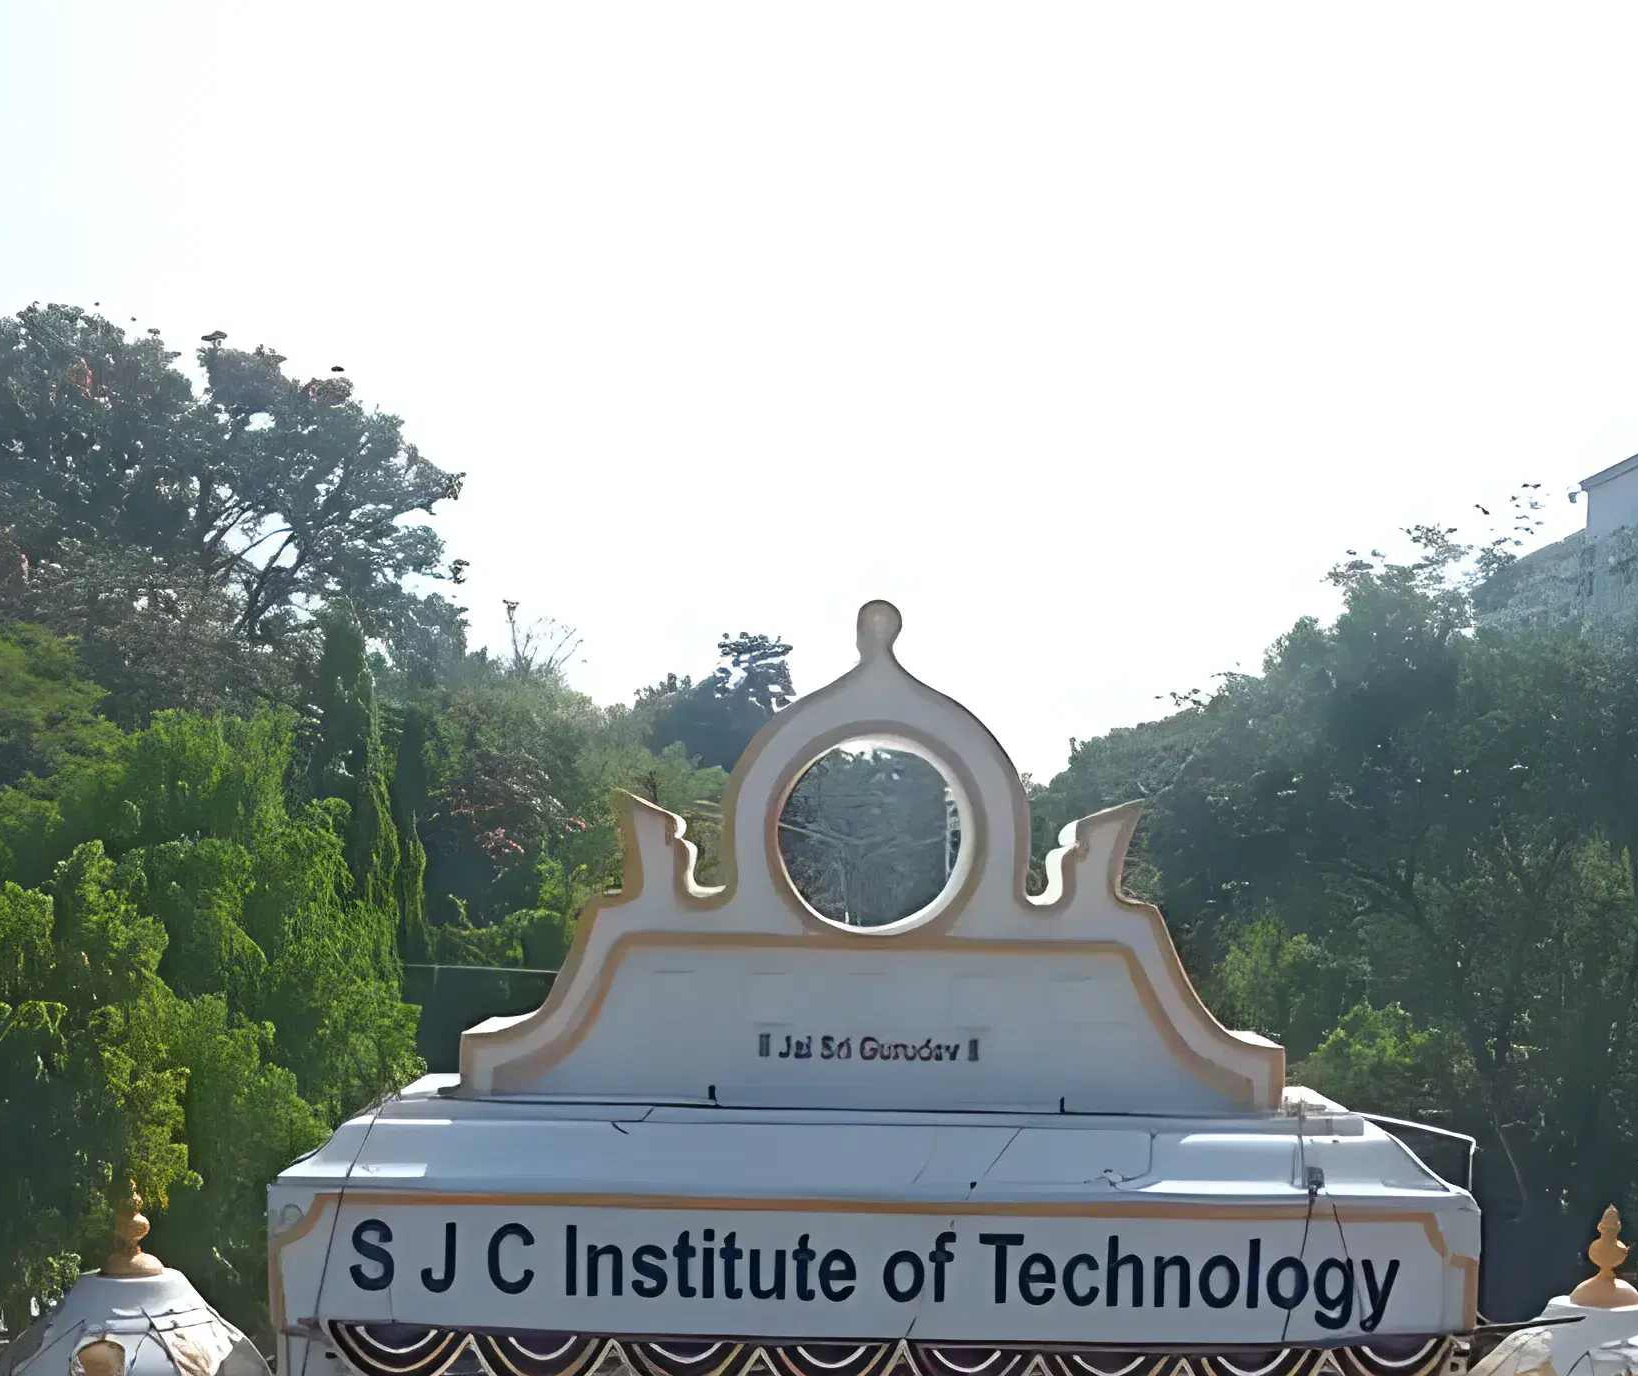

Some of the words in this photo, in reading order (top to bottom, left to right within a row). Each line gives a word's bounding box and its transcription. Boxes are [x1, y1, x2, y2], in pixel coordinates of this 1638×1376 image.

[349, 1218, 395, 1292] S
[420, 1221, 457, 1294] J
[487, 1222, 535, 1296] C
[565, 1224, 857, 1303] Institute
[882, 1231, 957, 1304] of
[978, 1233, 1401, 1334] Technology
